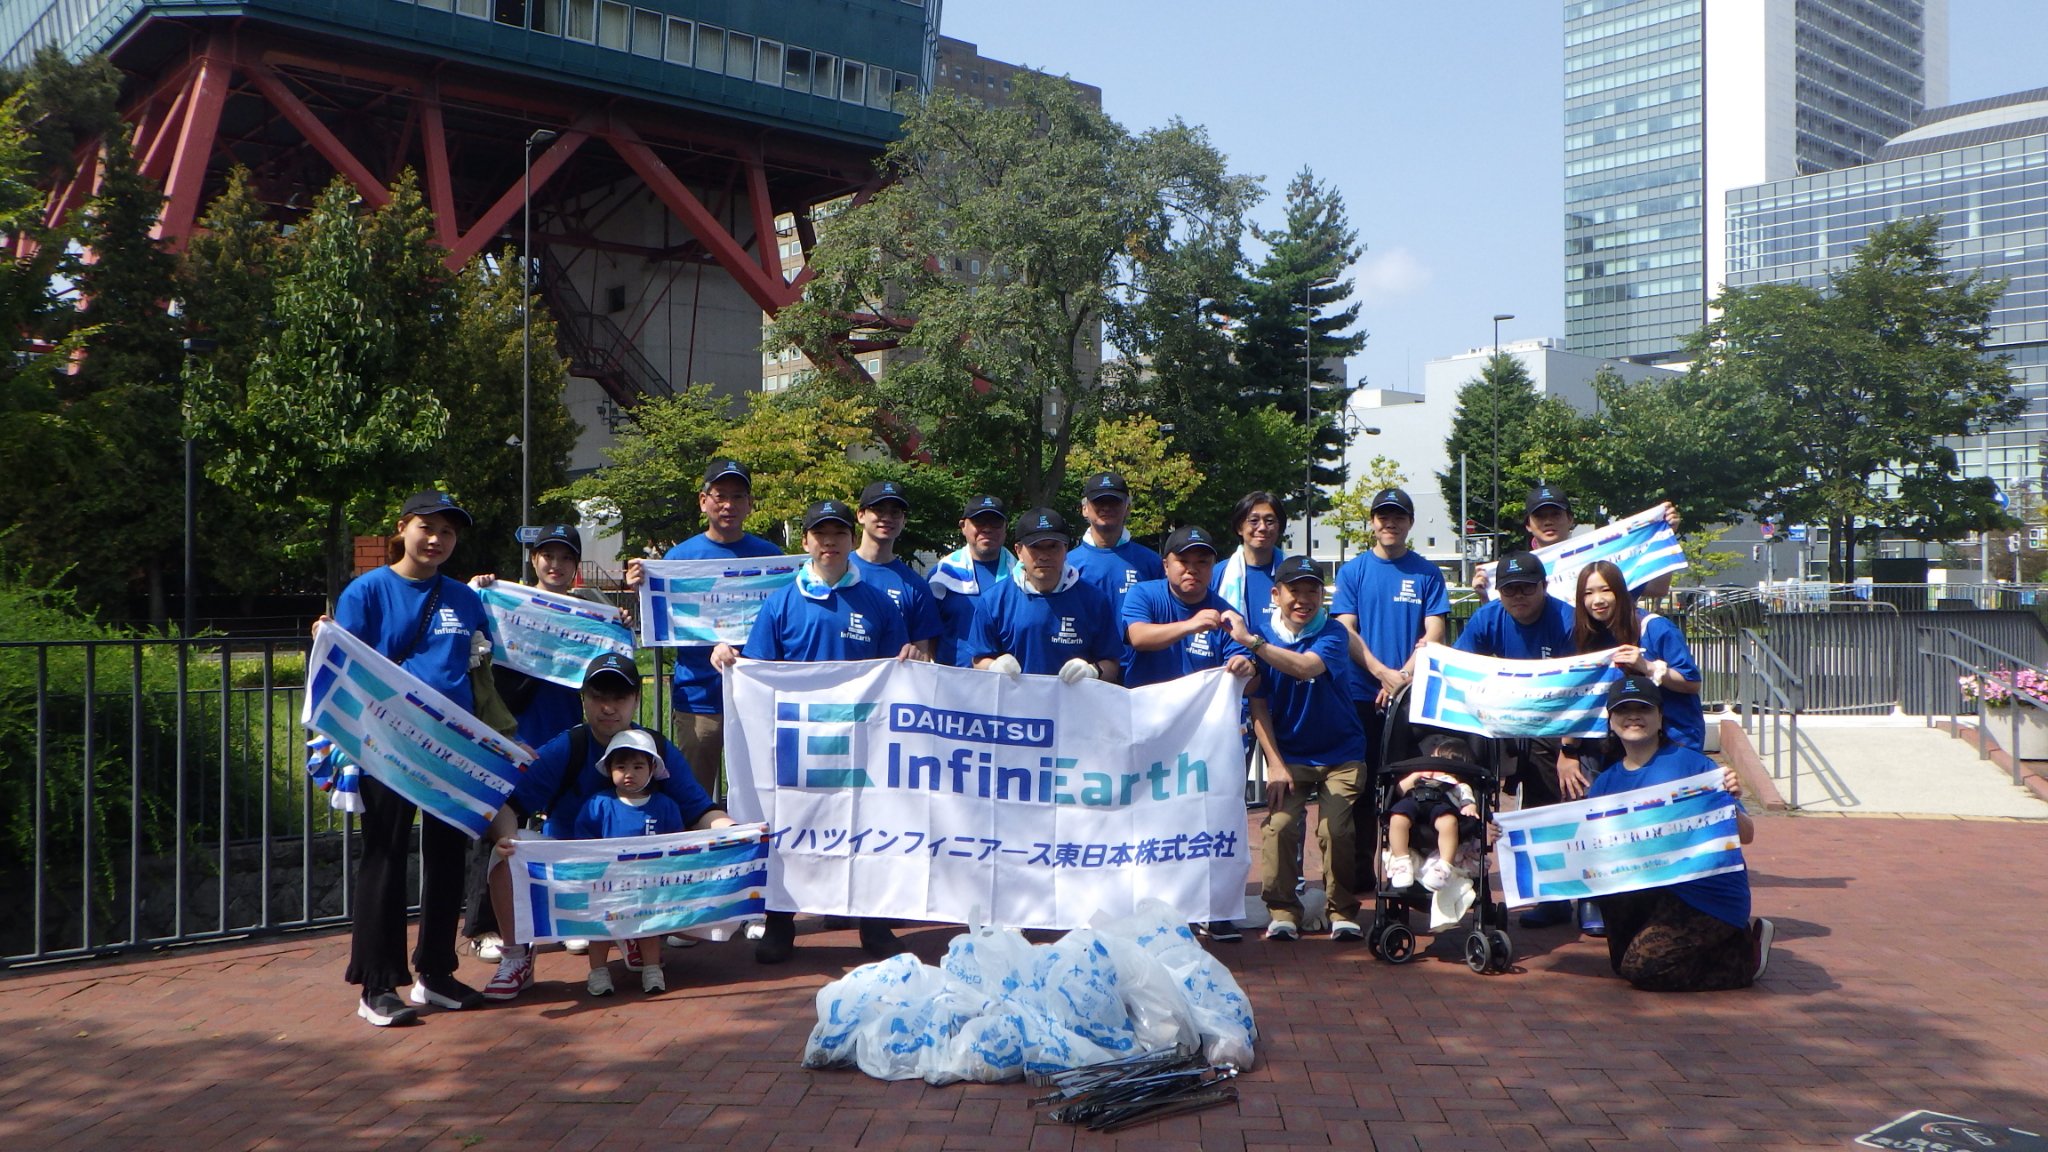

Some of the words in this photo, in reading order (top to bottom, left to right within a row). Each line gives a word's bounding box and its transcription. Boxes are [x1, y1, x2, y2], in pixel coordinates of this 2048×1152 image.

[896, 707, 1046, 742] DAIHATSU
[887, 742, 1209, 807] InfiniEarth
[769, 826, 1237, 869] イハツインフィニアース東日本株式会社
